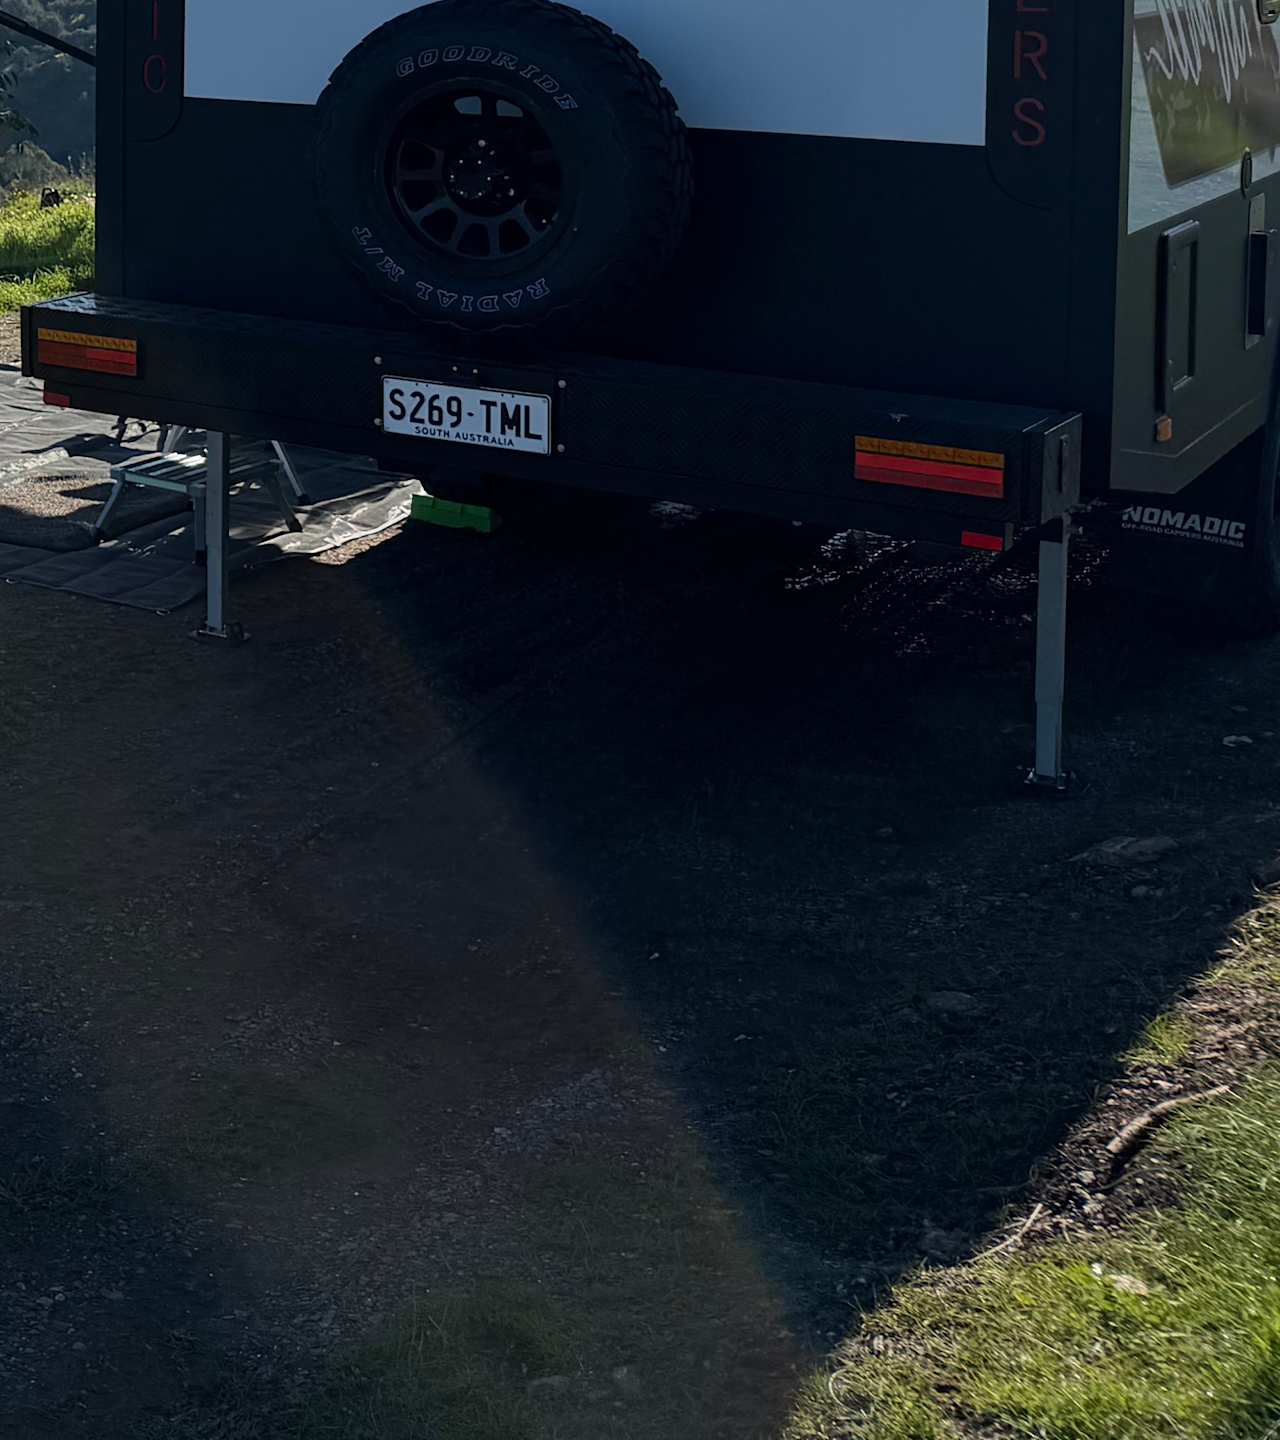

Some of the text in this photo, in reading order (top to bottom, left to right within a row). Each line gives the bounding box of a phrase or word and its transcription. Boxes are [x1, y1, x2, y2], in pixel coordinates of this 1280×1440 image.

[395, 45, 580, 111] GOODRIDE
[416, 278, 552, 313] RADIAL
[414, 426, 515, 448] SOUTH AUSTRALIA
[1122, 505, 1246, 540] NOMADIC
